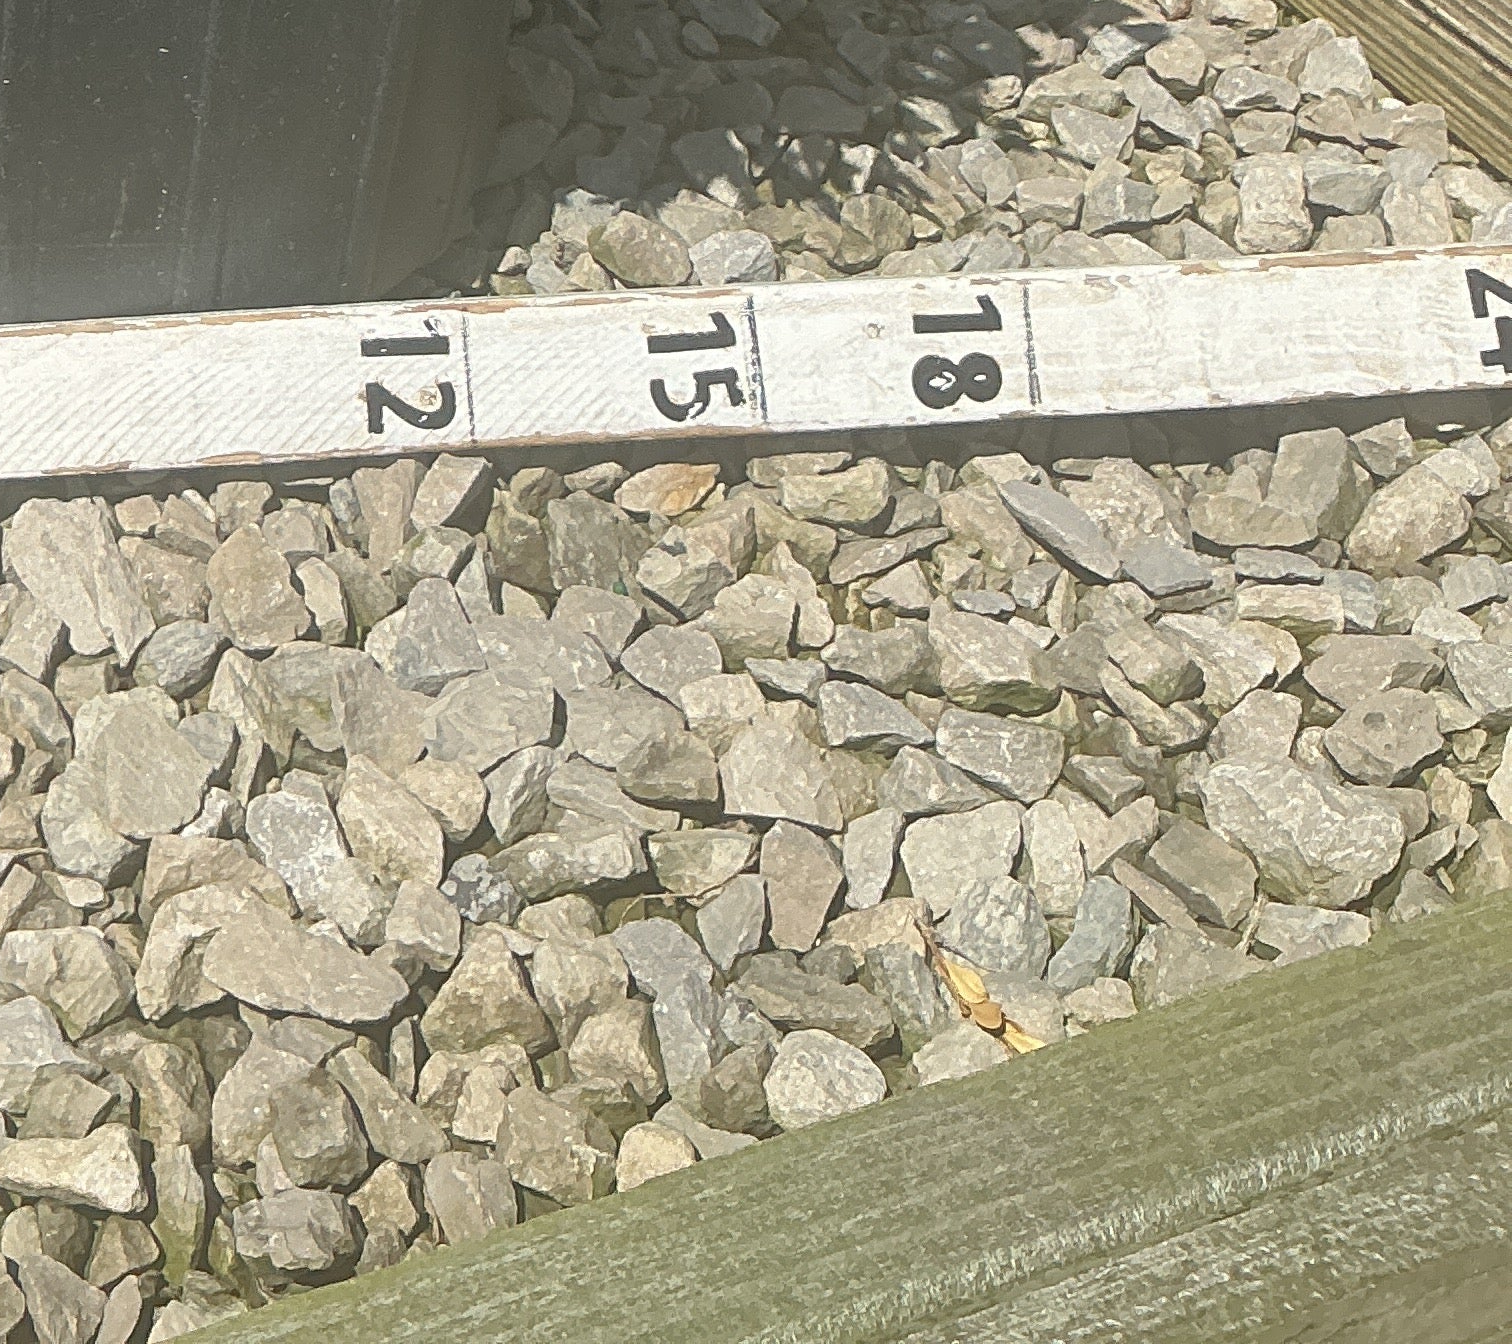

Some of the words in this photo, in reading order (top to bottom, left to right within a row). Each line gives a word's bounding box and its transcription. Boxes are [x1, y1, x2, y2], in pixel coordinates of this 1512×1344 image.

[361, 318, 456, 434] 12
[647, 311, 746, 422] 15
[912, 294, 1003, 409] 18
